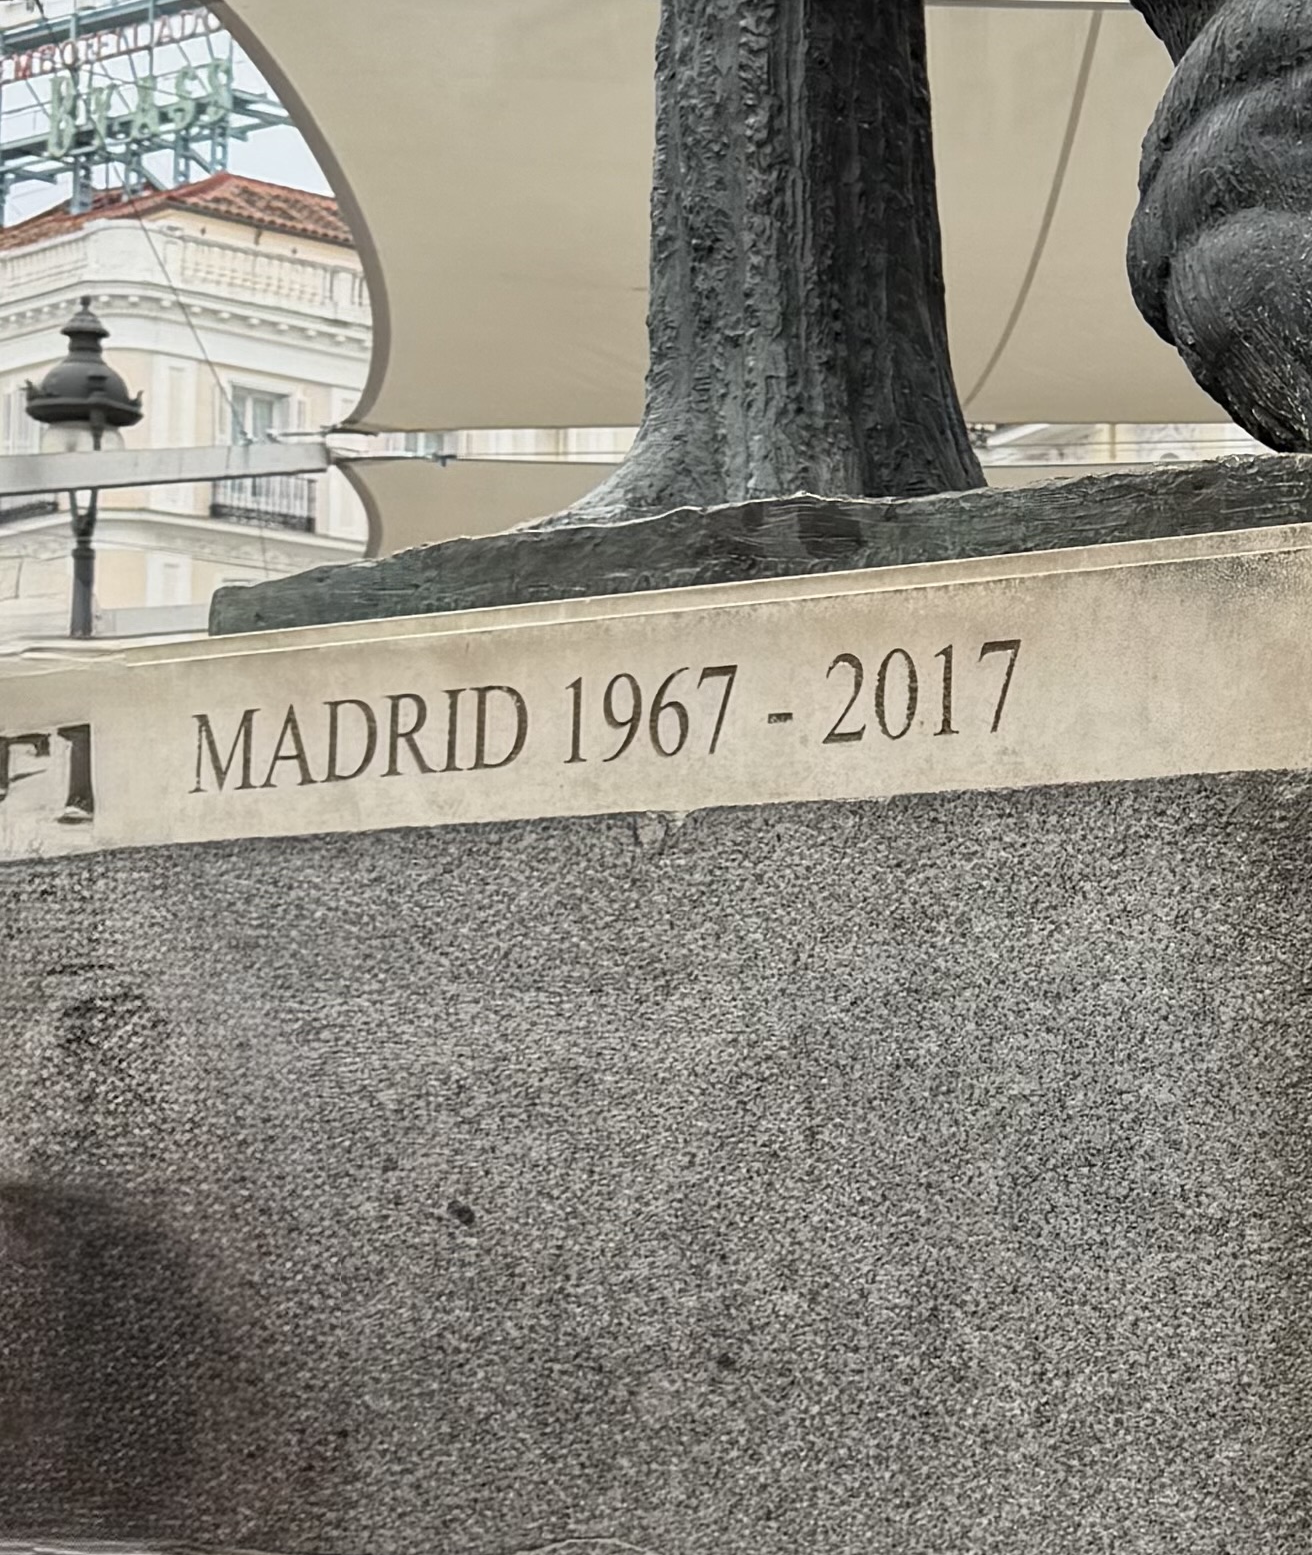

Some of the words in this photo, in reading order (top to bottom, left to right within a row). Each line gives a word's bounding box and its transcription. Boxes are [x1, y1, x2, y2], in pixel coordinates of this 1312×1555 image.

[188, 684, 530, 794] MADRID
[564, 665, 739, 765] 1967
[767, 710, 794, 725] -
[821, 638, 1022, 744] 2017
